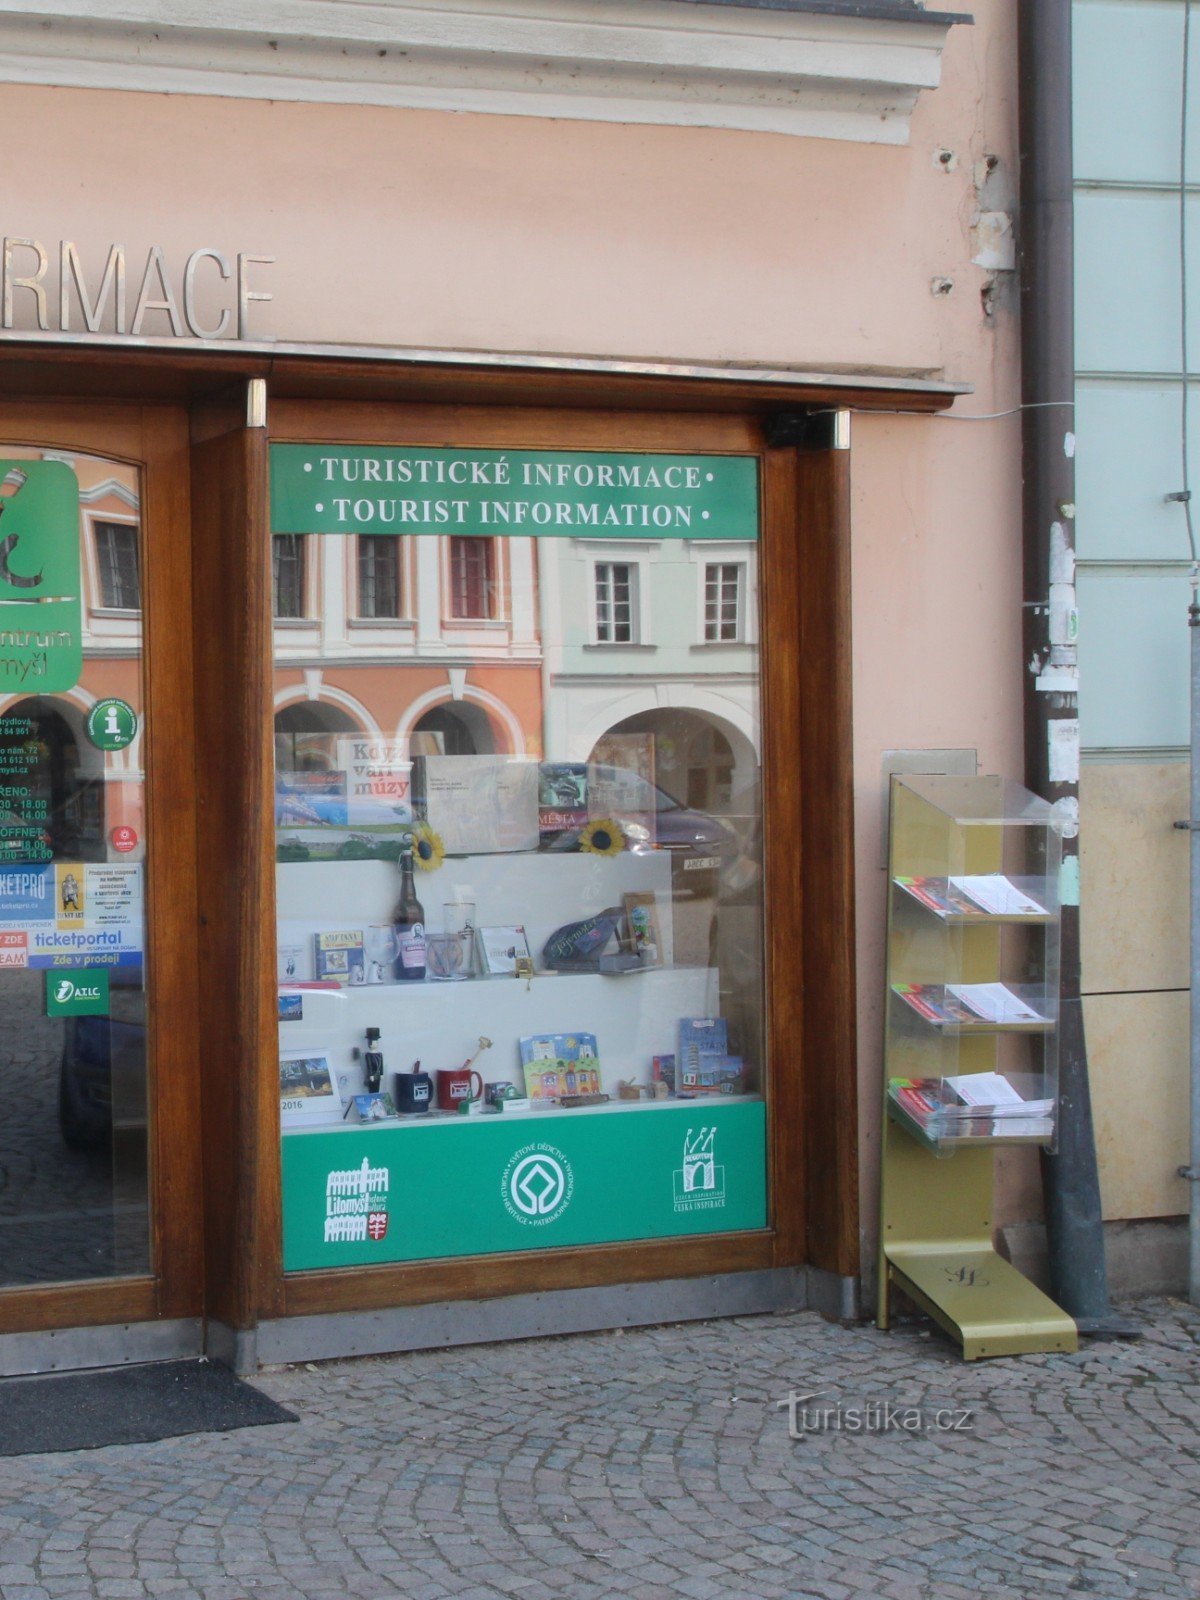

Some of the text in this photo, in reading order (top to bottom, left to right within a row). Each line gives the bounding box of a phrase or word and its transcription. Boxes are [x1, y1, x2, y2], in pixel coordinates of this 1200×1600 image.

[320, 457, 700, 489] TURISTICKÉ INFORMACE
[333, 498, 693, 528] TOURIST INFORMATION
[21, 800, 47, 809] 18.00
[21, 811, 47, 820] 14.00
[4, 935, 23, 944] ZDE
[35, 930, 121, 949] ticketportal
[53, 953, 120, 966] Zde v prodeji
[282, 1101, 303, 1110] 2016
[327, 1192, 369, 1217] Litomyšl
